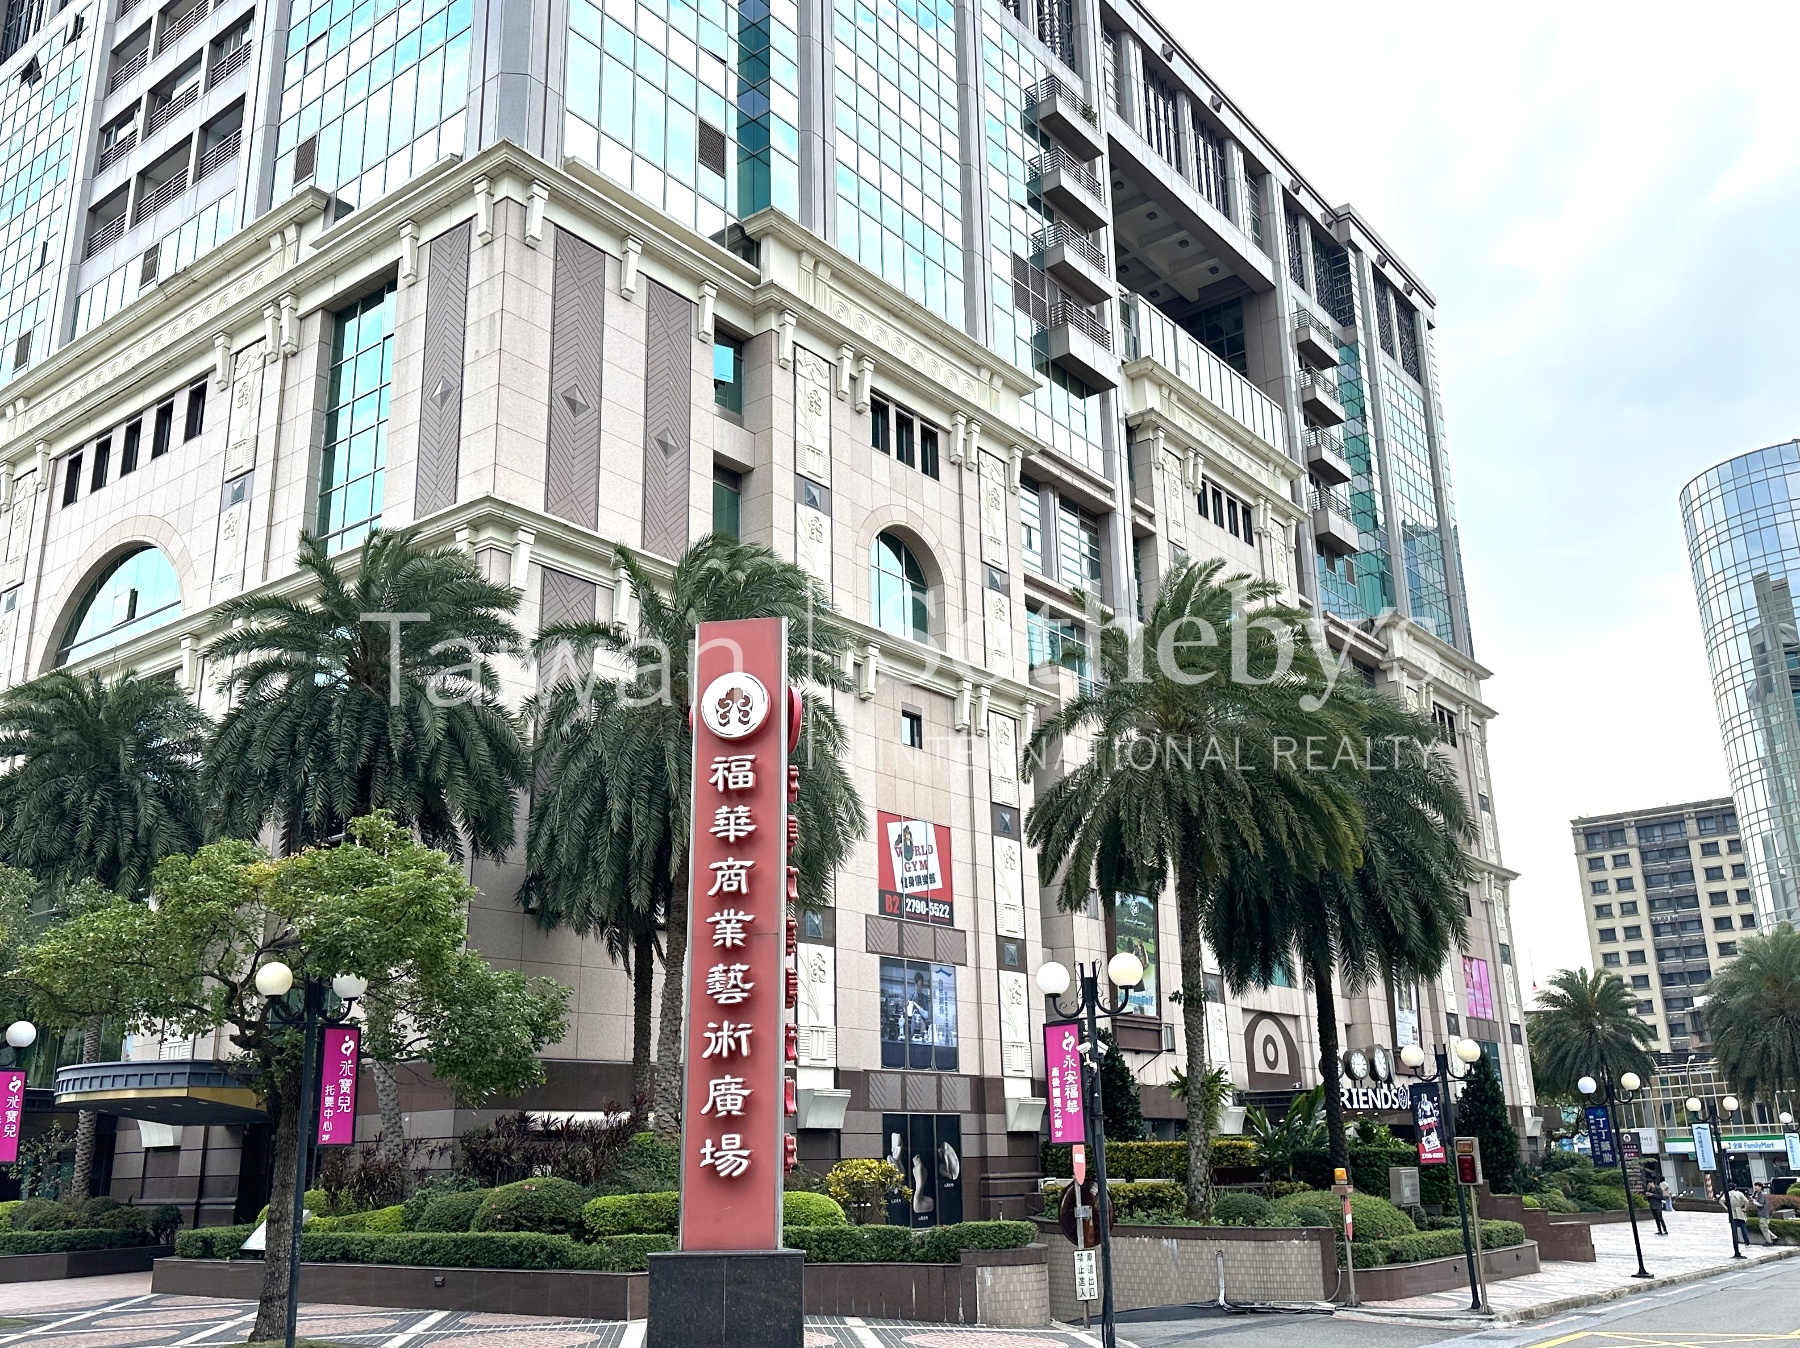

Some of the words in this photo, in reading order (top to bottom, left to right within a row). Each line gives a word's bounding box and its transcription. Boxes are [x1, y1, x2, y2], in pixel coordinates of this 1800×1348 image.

[904, 860, 928, 872] GYM
[885, 894, 900, 914] B2
[906, 898, 950, 918] 2790-5522
[700, 754, 757, 1177] 福華商業藝術廣場
[1062, 1055, 1080, 1115] 永安福華
[1340, 1087, 1399, 1110] RIENDS
[322, 1085, 335, 1132] 托嬰中心
